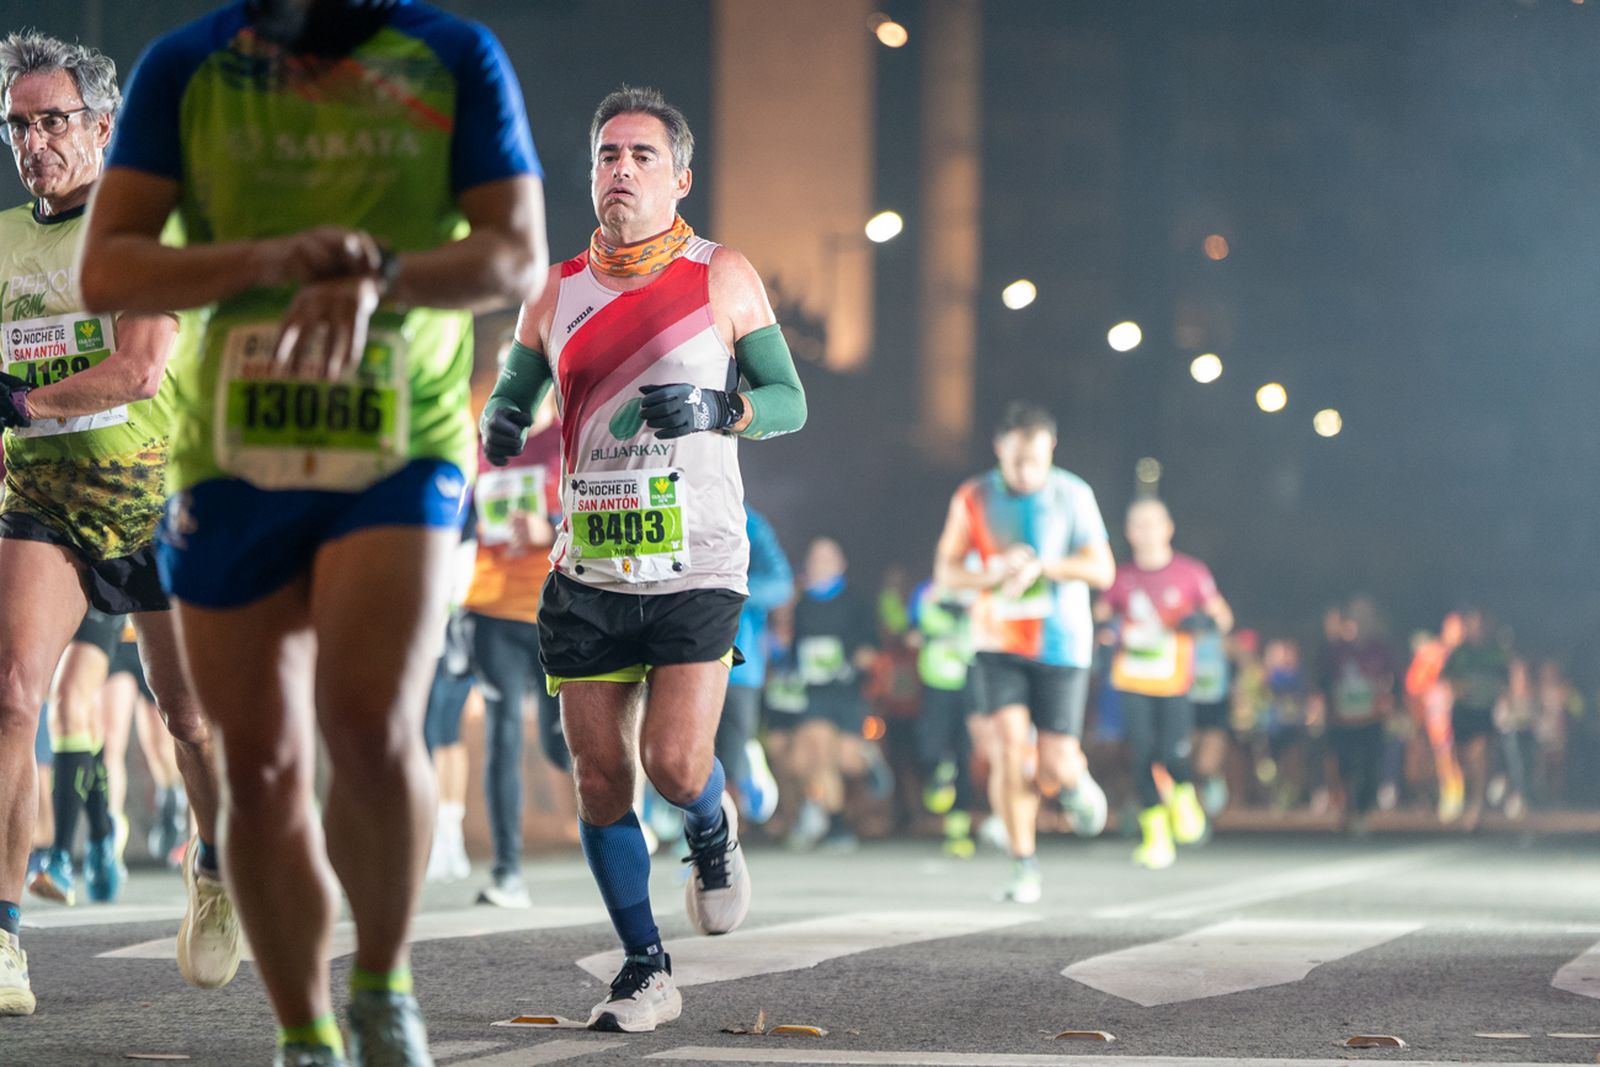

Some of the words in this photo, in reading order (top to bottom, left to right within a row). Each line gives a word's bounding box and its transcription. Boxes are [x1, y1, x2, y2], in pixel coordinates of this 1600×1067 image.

[23, 330, 53, 344] NOCHE
[55, 329, 65, 340] DE
[14, 347, 32, 361] SAN
[34, 342, 66, 357] ANTÓN
[244, 383, 381, 432] 13066
[588, 483, 621, 496] NOCHE
[624, 483, 637, 494] DE
[578, 500, 597, 511] SAN
[600, 495, 638, 510] ANTÓN
[587, 511, 665, 546] 8403
